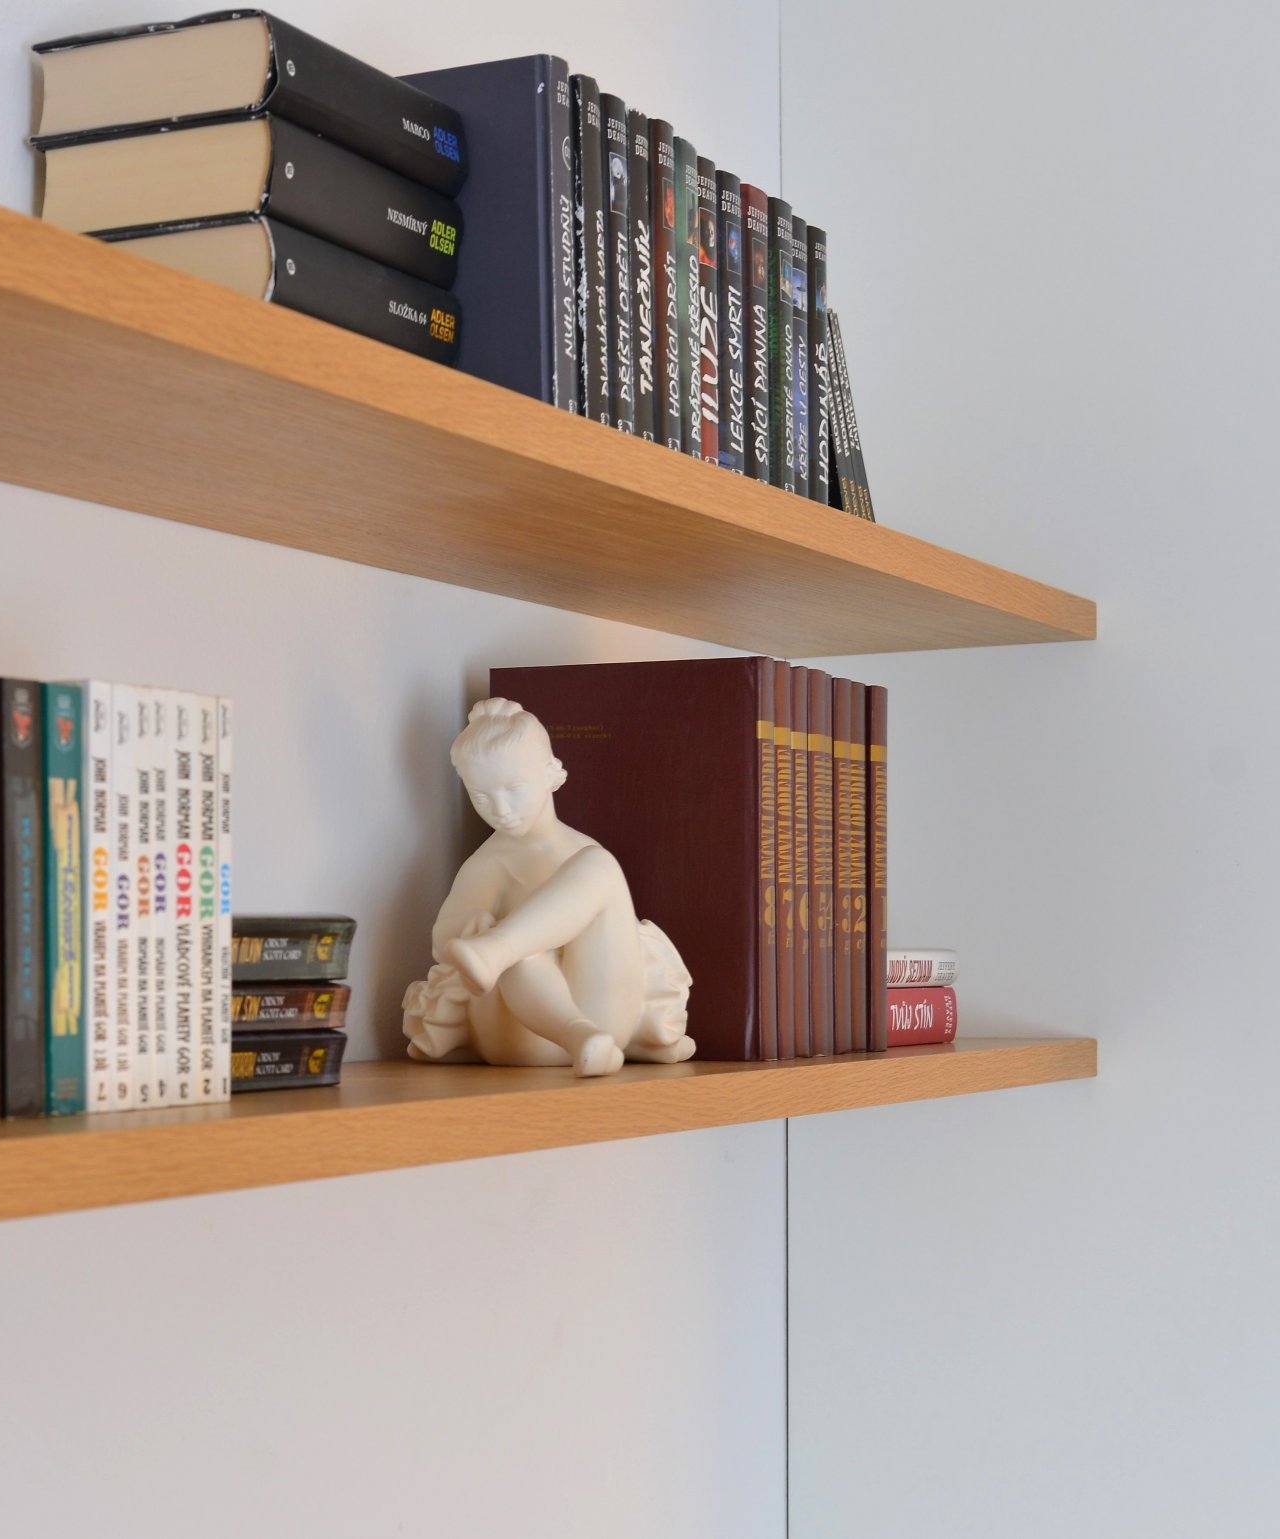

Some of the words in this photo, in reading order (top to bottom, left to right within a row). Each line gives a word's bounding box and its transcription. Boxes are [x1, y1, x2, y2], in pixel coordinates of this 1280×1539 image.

[402, 118, 430, 141] MARCO
[433, 126, 459, 147] ADLER
[434, 139, 460, 163] OLSEN
[386, 207, 428, 236] NESMÍRNÝ
[429, 233, 455, 256] OLSEN
[431, 219, 457, 242] ADLER
[559, 194, 573, 288] STUDŇŮ
[615, 231, 630, 314] OBĚTI
[663, 251, 678, 321] DRÁT
[687, 254, 700, 337] KŘESLO
[388, 300, 419, 324] SLOŽKA
[429, 321, 455, 344] OLSEN
[430, 308, 456, 328] ADLER
[563, 296, 574, 359] NULA
[634, 219, 654, 395] TANEČNÍK
[727, 284, 744, 364] SMRTI
[616, 315, 632, 402] PŘÍŠTÍ
[665, 323, 680, 418] HOŘÍCÍ
[700, 285, 719, 425] ILUZE
[753, 304, 768, 394] PANNA
[785, 323, 795, 382] OKNO
[797, 335, 808, 398] CESTY
[688, 333, 702, 443] PRÁZDNÉ
[729, 368, 745, 454] LEKCE
[813, 340, 830, 486] HODINÁŘ
[751, 396, 769, 466] SPÍCÍ
[783, 384, 795, 469] ROZBITÉ
[175, 748, 191, 780] JOHN
[198, 750, 214, 782] JOHN
[177, 787, 191, 840] NORMAN
[201, 789, 214, 840] NORMAN
[91, 847, 110, 912] GOR
[116, 874, 131, 931] GOR
[137, 855, 151, 917] GOR
[154, 853, 167, 914] GOR
[176, 843, 193, 919] GOR
[198, 846, 215, 920] GOR
[220, 863, 231, 915] GOR
[853, 895, 866, 932] 2
[176, 923, 193, 988] VLÁDCOVÉ
[176, 991, 191, 1043] PLANETY
[889, 1001, 913, 1031] TVŮJ
[913, 998, 934, 1031] STÍN
[176, 1046, 191, 1074] GOR
[200, 1048, 214, 1071] GOR
